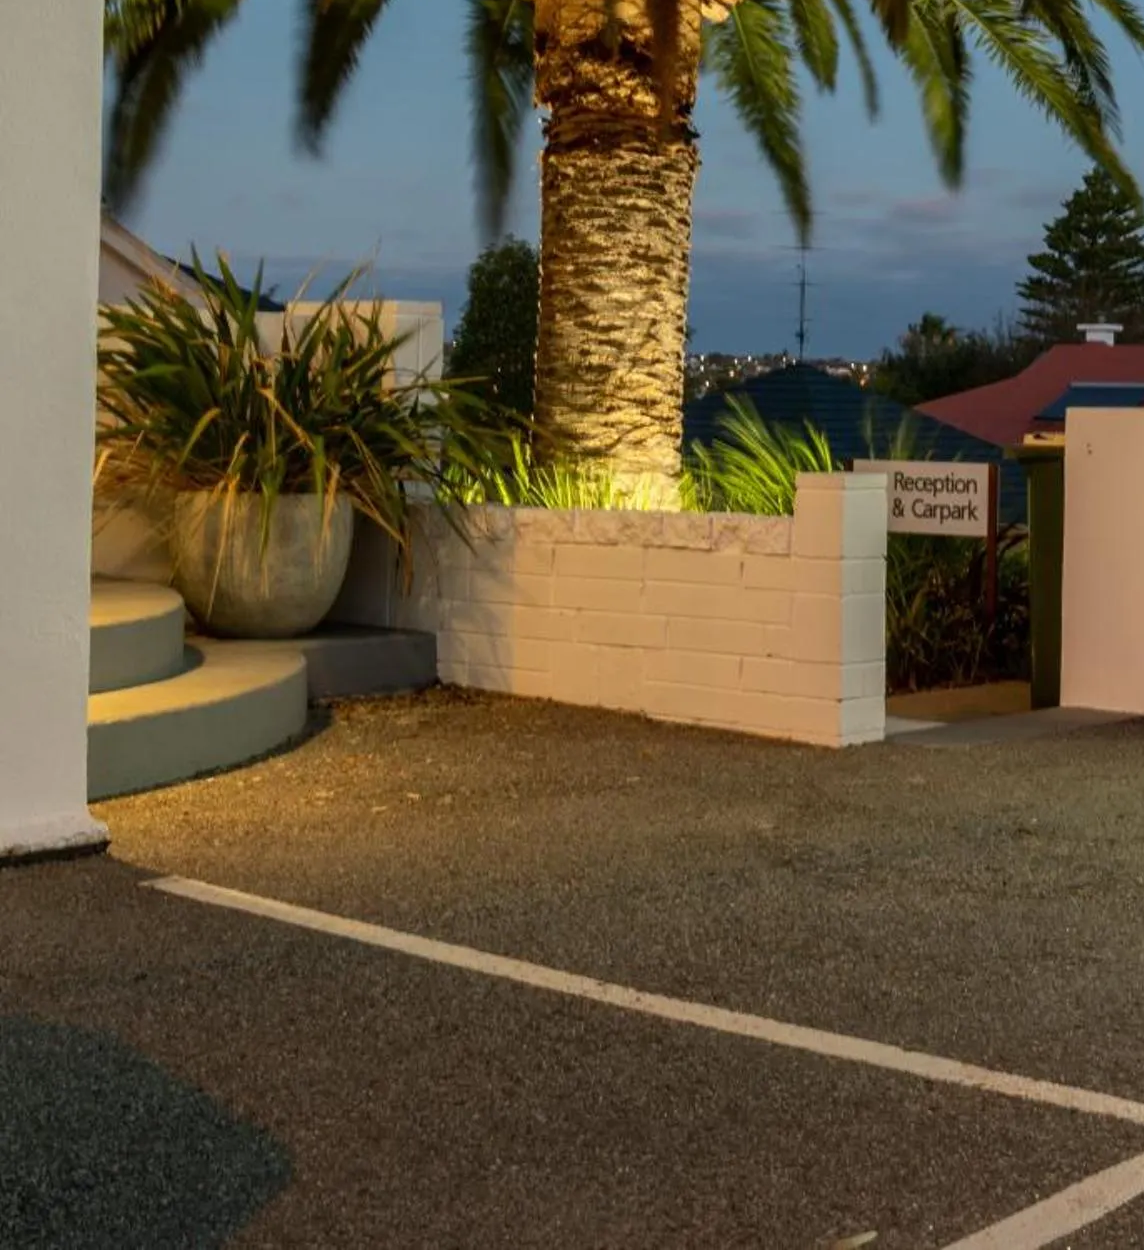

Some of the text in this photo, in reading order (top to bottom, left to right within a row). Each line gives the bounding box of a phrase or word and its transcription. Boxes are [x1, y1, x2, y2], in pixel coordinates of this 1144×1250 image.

[893, 471, 978, 497] Reception
[892, 497, 979, 524] & Carpark
